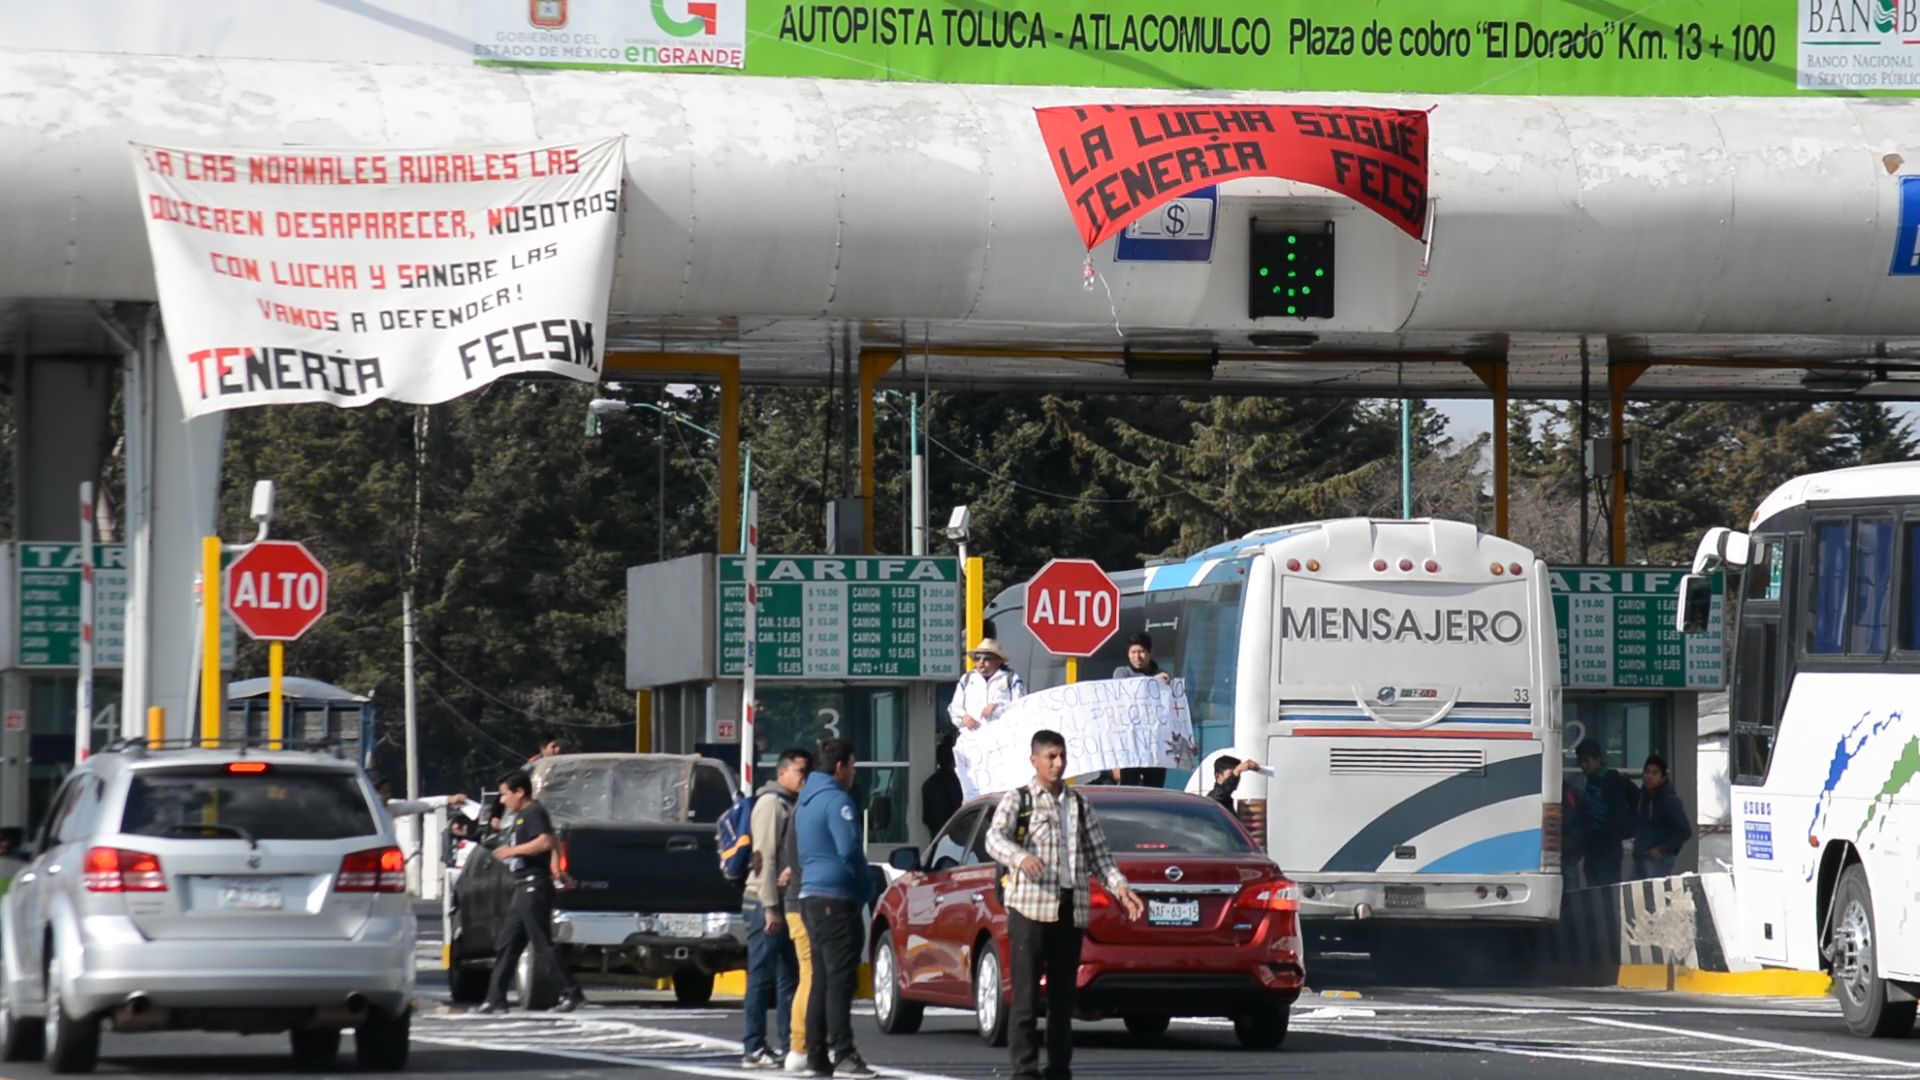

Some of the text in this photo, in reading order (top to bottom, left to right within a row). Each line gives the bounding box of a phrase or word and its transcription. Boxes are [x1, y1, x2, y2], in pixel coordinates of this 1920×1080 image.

[496, 31, 600, 45] GOBIERNO DEL
[779, 5, 934, 46] AUTOPISTA
[942, 9, 1046, 48] TOLUCA
[1069, 13, 1270, 55] ATLACOMULCO
[1289, 18, 1354, 56] Plaza
[1362, 19, 1391, 56] de
[1400, 20, 1470, 57] cobro
[1618, 23, 1667, 60] Km.
[1676, 24, 1701, 61] 13
[1709, 34, 1723, 52] +
[1733, 24, 1775, 62] 100
[475, 44, 620, 59] ESTADO DE MÉXICO
[1807, 54, 1914, 68] BANCO NACIONAL
[1805, 73, 1813, 85] Y
[1818, 72, 1877, 86] SERVICIOS
[1059, 125, 1113, 186] LA
[1130, 111, 1275, 147] LUCHA
[186, 155, 236, 182] LAS
[249, 155, 388, 184] NORMALES
[401, 153, 518, 183] RURALES
[531, 149, 579, 177] LAS
[150, 190, 617, 240] QUIEREN DESAPARECER, NOSOTROS
[210, 243, 558, 290] CON LUCHA Y SANGRE LAS
[257, 284, 523, 333] VAMOS A DEFENDER!
[732, 560, 945, 580] TARIFA
[1550, 573, 1679, 592] ARIF
[234, 571, 320, 610] ALTO
[808, 588, 813, 597] $
[852, 587, 881, 598] CAMION
[898, 587, 916, 598] EJES
[923, 589, 927, 598] $
[808, 603, 813, 613] $
[852, 602, 881, 613] CAMION
[898, 602, 916, 613] EJES
[923, 603, 927, 612] $
[1033, 588, 1112, 627] ALTO
[1575, 599, 1580, 608] $
[1618, 599, 1646, 610] CAMION
[1663, 599, 1678, 610] EJE
[777, 617, 782, 628] 2
[783, 617, 801, 628] EJES
[808, 617, 813, 627] $
[852, 617, 881, 628] CAMION
[898, 617, 916, 628] EJES
[923, 618, 927, 627] $
[1575, 614, 1580, 624] $
[1618, 614, 1646, 625] CAMION
[1663, 614, 1677, 625] EJE
[1283, 607, 1526, 643] MENSAJERO
[777, 631, 782, 643] 3
[783, 631, 801, 643] EJES
[808, 633, 813, 642] $
[852, 633, 881, 643] CAMION
[898, 633, 916, 643] EJES
[923, 633, 927, 642] $
[1575, 629, 1580, 638] $
[1618, 629, 1646, 640] CAMION
[1663, 629, 1680, 640] EJES
[777, 647, 782, 658] 4
[783, 647, 801, 658] EJES
[808, 648, 813, 658] $
[852, 648, 881, 658] CAMION
[898, 648, 916, 658] EJES
[923, 648, 927, 657] $
[1575, 645, 1580, 654] $
[1618, 644, 1646, 655] CAMION
[1663, 644, 1680, 655] EJES
[777, 662, 782, 673] 5
[783, 662, 801, 673] EJES
[808, 663, 813, 673] $
[852, 663, 872, 673] AUTO
[885, 663, 898, 673] EJE
[923, 664, 927, 673] $
[1575, 660, 1580, 669] $
[1618, 659, 1646, 670] CAMION
[1663, 659, 1680, 670] EJES
[1575, 674, 1580, 683] $
[1618, 674, 1637, 685] AUTO
[1651, 674, 1664, 685] EJE
[1023, 679, 1162, 719] GASOLINAZO
[1514, 688, 1530, 702] 33
[92, 703, 119, 730] 4
[818, 708, 840, 744] 3
[1565, 719, 1586, 758] 2
